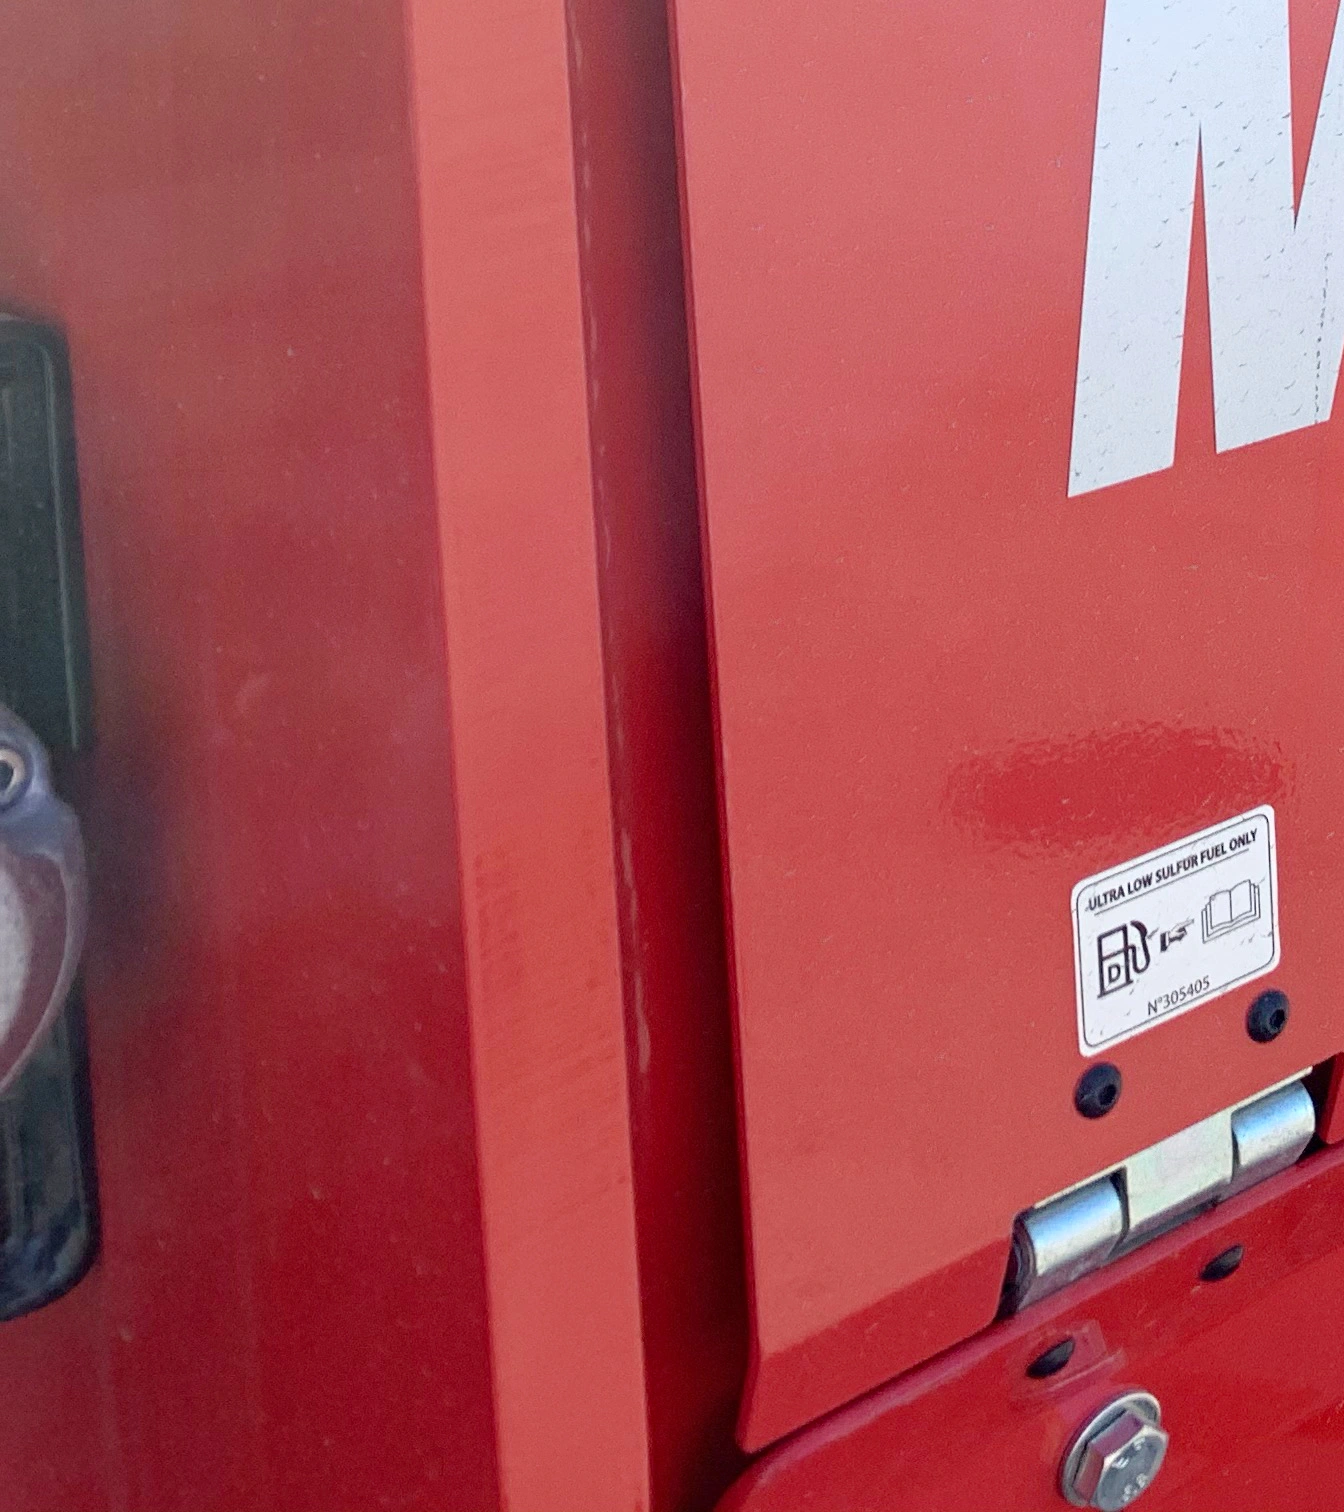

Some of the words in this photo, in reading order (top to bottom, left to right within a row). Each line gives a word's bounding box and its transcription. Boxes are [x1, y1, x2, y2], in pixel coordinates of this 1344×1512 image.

[1088, 885, 1125, 911] ULTRA
[1127, 872, 1153, 895] LOW
[1155, 854, 1198, 884] SULFUR
[1200, 842, 1226, 864] FUEL
[1229, 828, 1257, 851] ONLY
[1147, 975, 1210, 1015] N°305405
